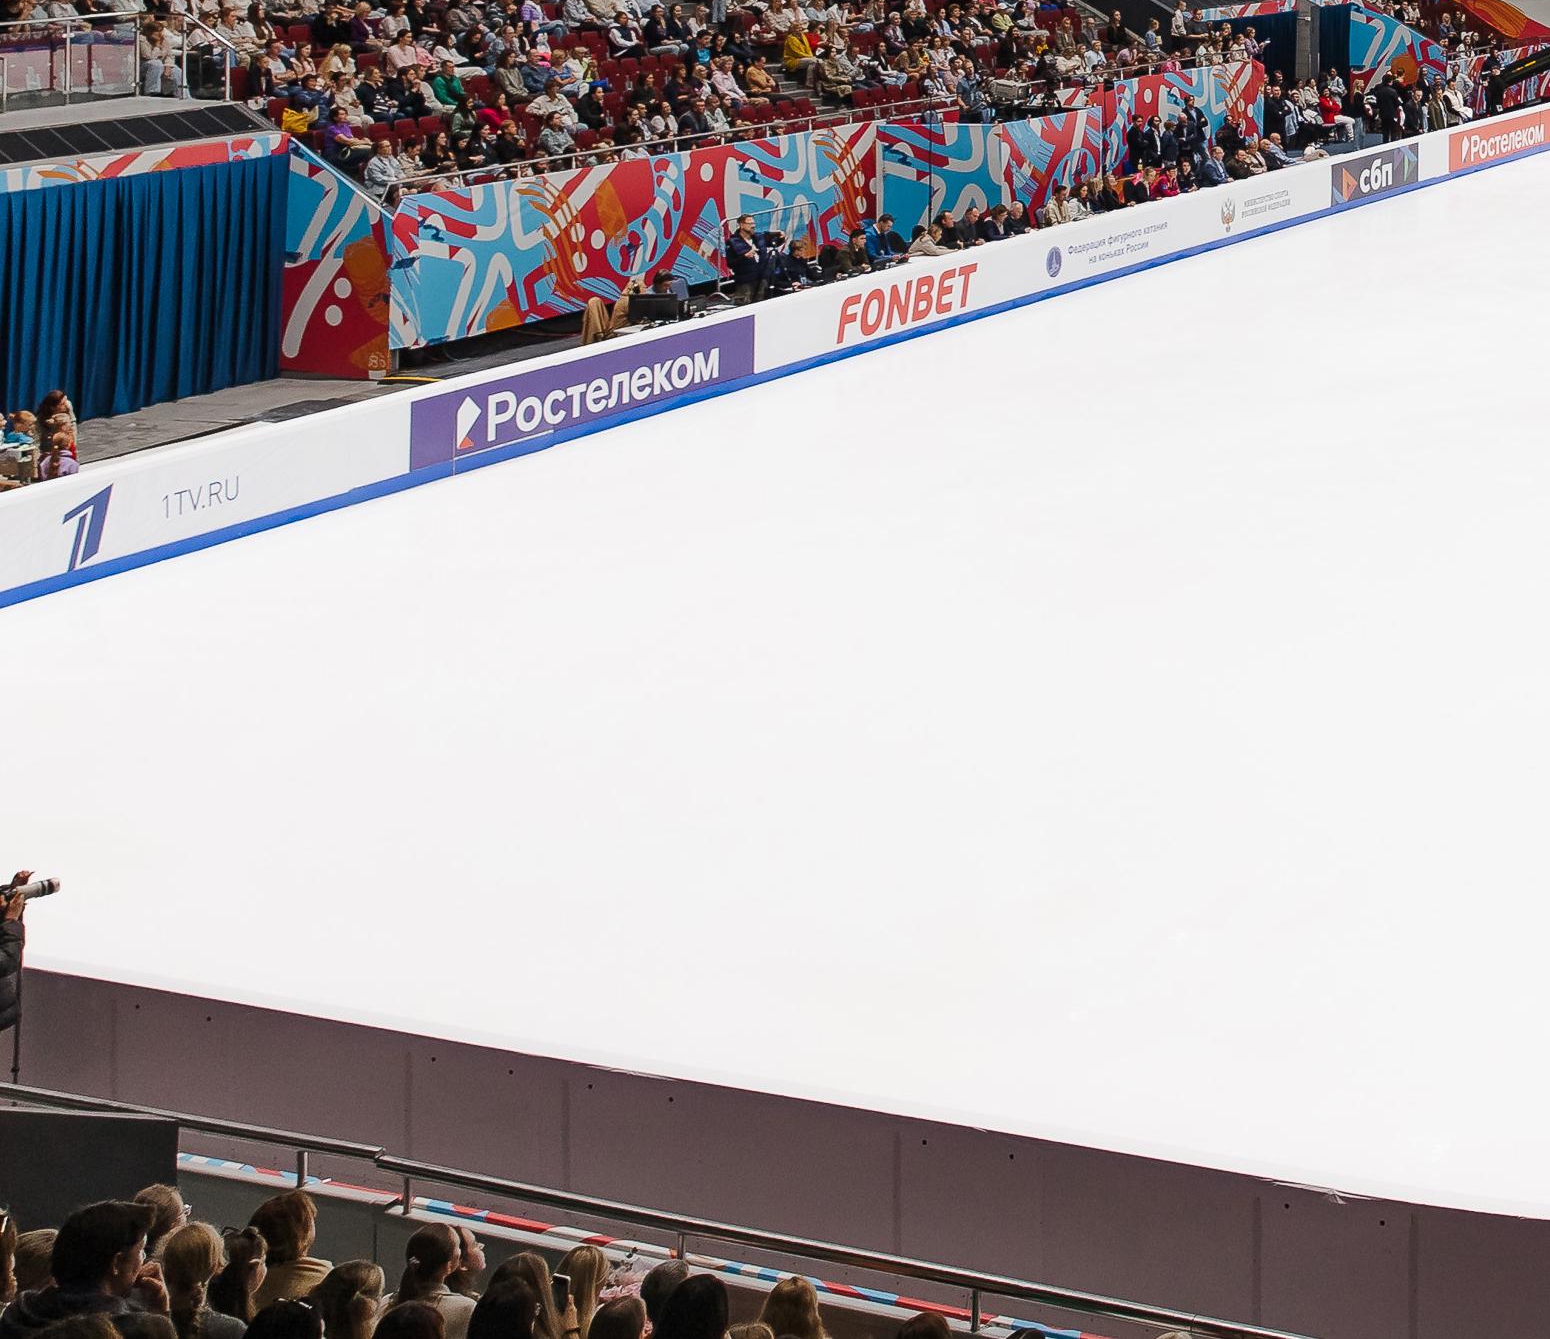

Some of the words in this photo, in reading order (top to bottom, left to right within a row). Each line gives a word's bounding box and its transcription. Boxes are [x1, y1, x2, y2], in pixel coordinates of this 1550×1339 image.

[1470, 124, 1545, 162] Ростелеком
[1359, 159, 1393, 193] сбп
[1068, 238, 1106, 255] Федерация
[1107, 228, 1142, 247] фигурного
[1143, 221, 1168, 235] катания
[1088, 255, 1097, 264] на
[1099, 247, 1125, 262] коньках
[1125, 241, 1149, 255] России
[837, 263, 978, 345] FONBET
[486, 346, 720, 442] Ростелеком
[161, 476, 240, 519] 1TV.RU
